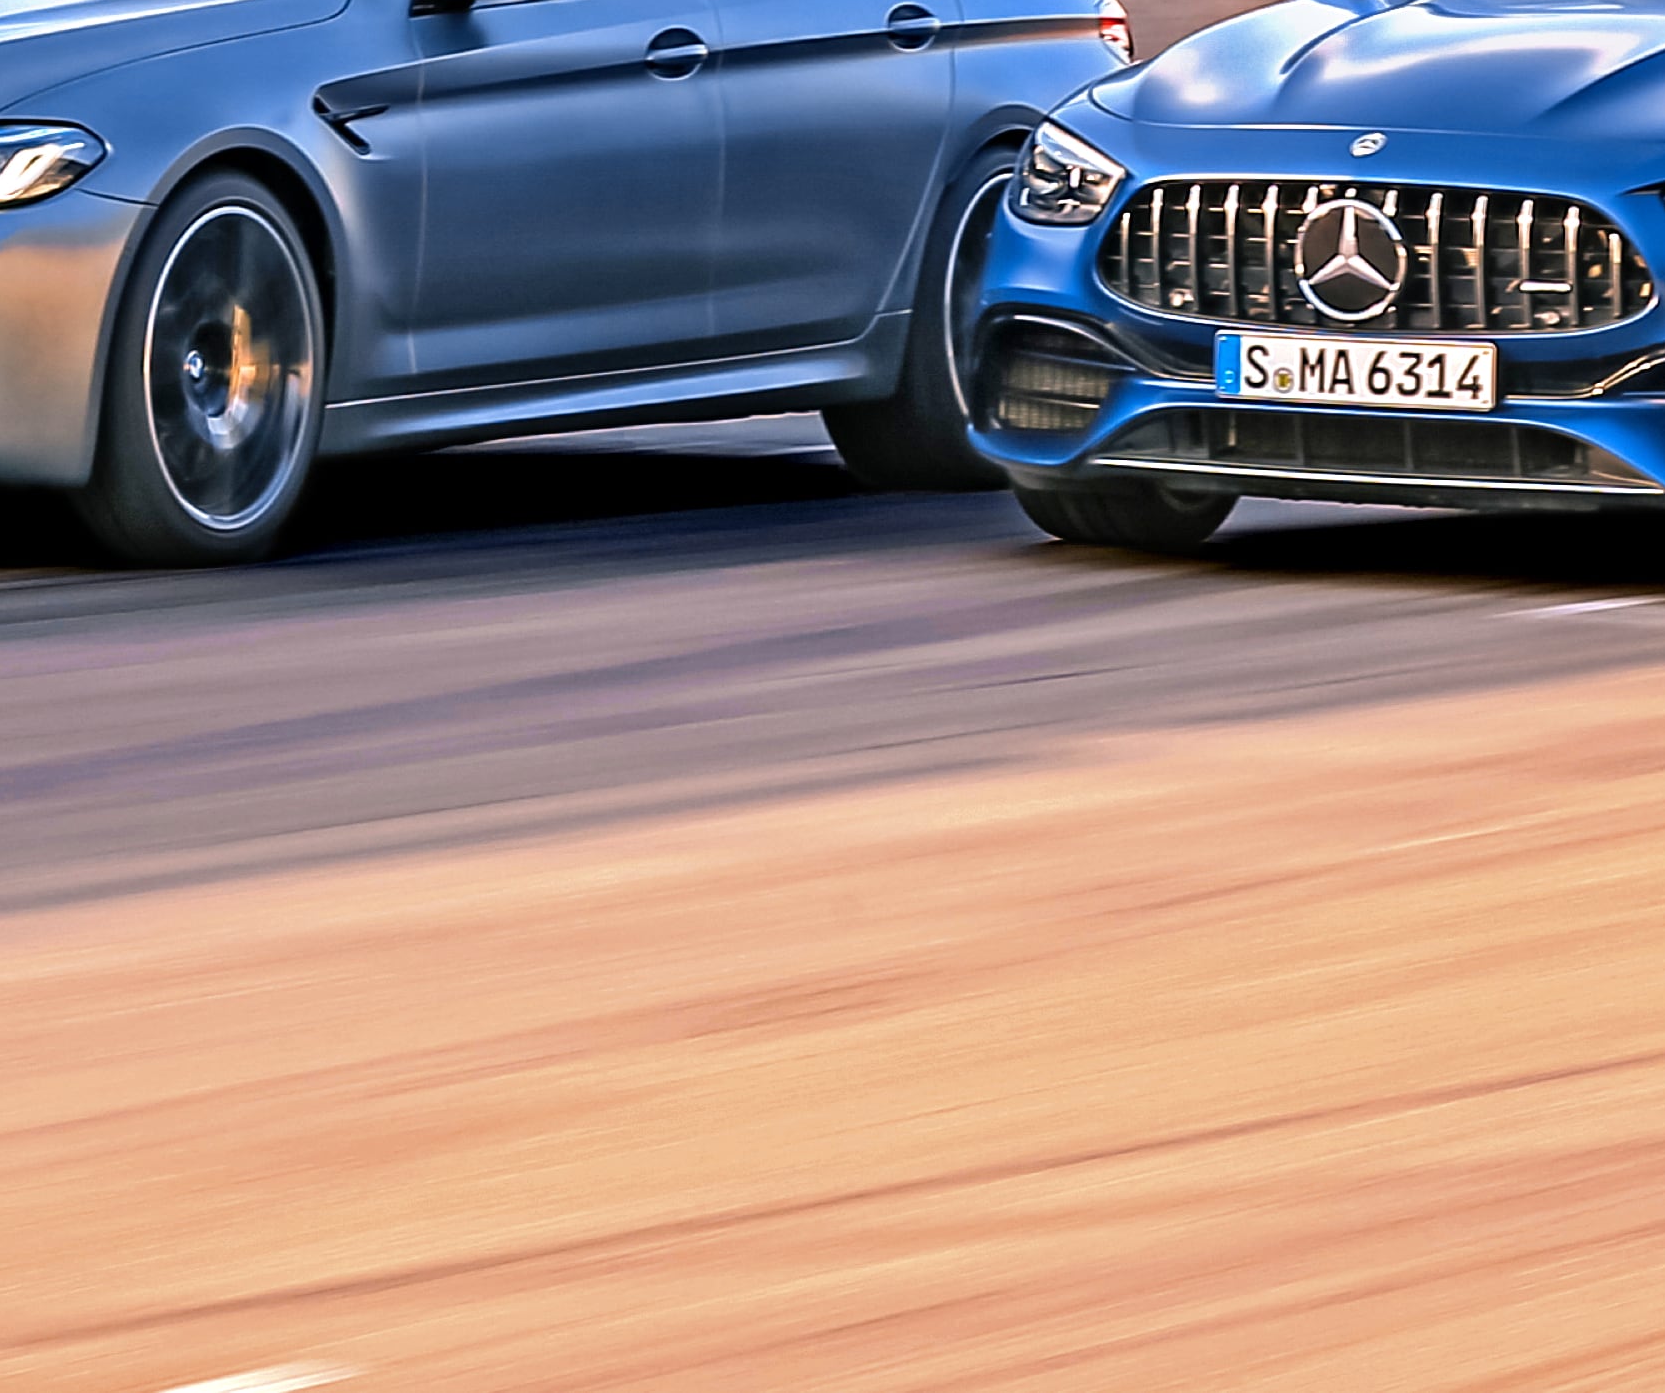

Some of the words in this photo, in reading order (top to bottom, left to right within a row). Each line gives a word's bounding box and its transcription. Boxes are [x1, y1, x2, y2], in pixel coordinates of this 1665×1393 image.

[1244, 344, 1270, 389] S
[1298, 347, 1355, 395] MA
[1367, 350, 1483, 400] 6314
